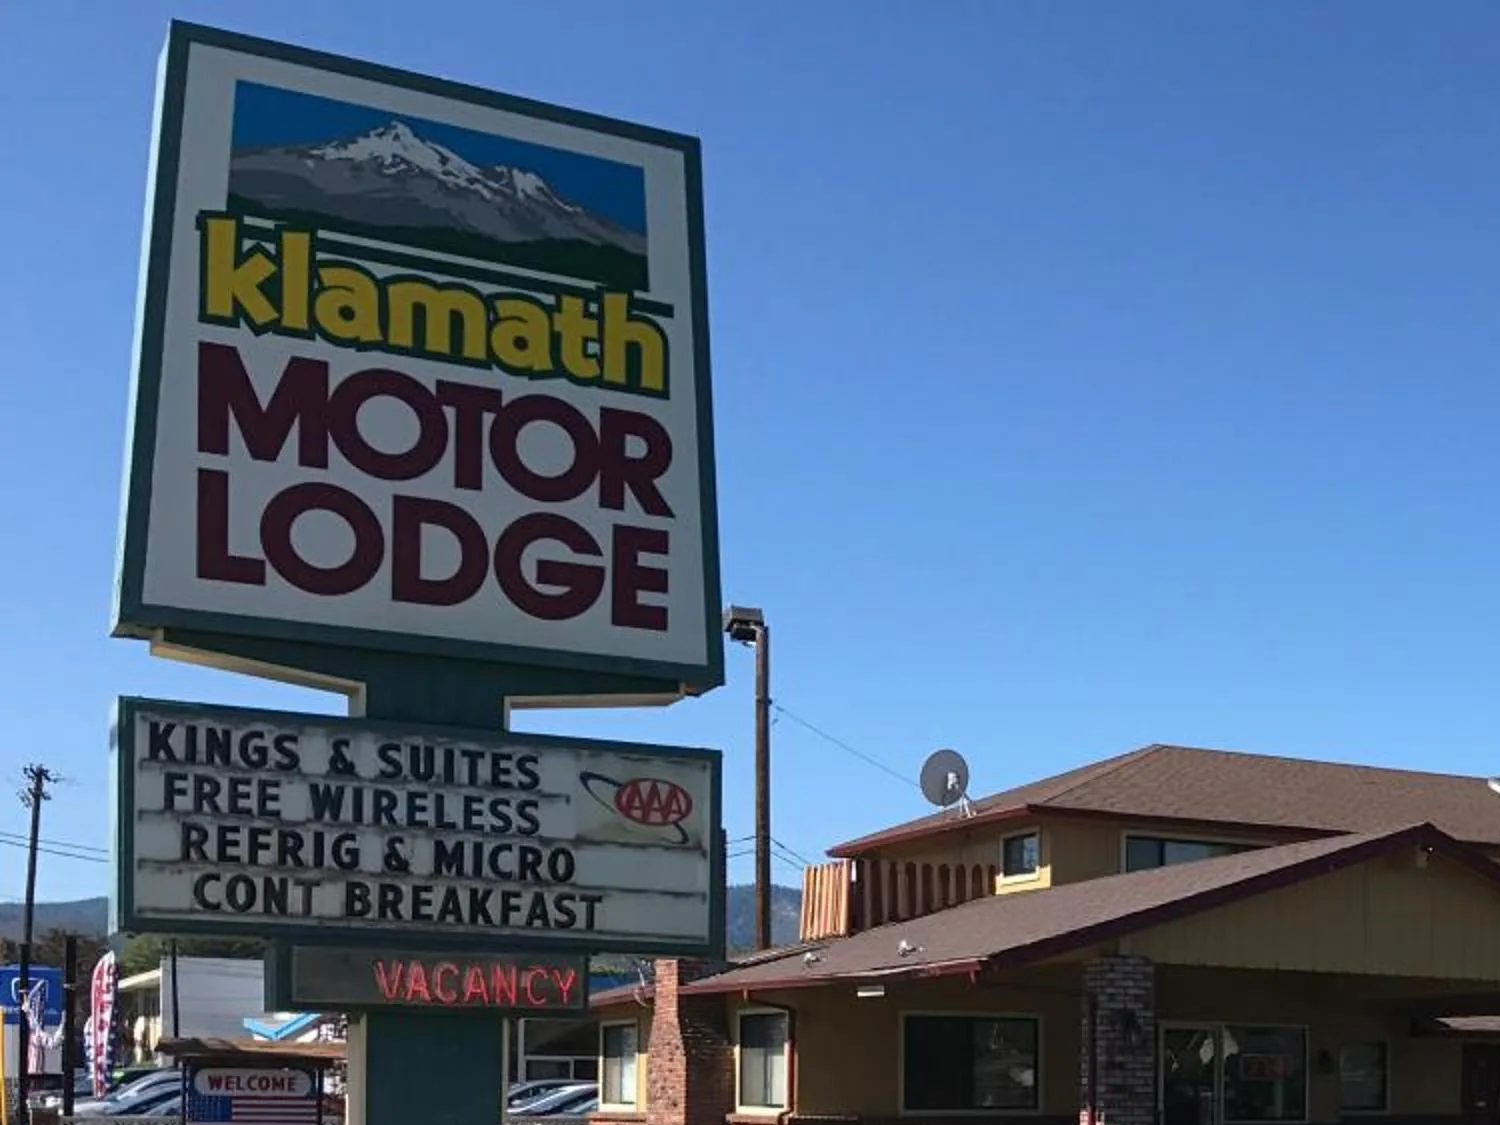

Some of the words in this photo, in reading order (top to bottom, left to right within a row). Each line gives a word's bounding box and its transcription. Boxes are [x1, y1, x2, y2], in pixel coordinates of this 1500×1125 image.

[200, 211, 669, 397] klamath
[198, 341, 675, 518] MOTOR
[196, 467, 669, 631] LODGE
[149, 721, 300, 771] KINGS
[329, 739, 356, 775] &
[378, 743, 541, 791] SUITES
[163, 772, 281, 817] FREE
[310, 783, 541, 836] WIRELESS
[615, 778, 692, 826] AAA
[181, 822, 359, 870] REFRIG
[383, 836, 409, 875] &
[433, 840, 575, 883] MICRO
[193, 873, 320, 916] CONT
[345, 881, 603, 930] BREAKFAST
[375, 959, 576, 1004] VACANCY
[207, 1075, 296, 1091] WELCOME
